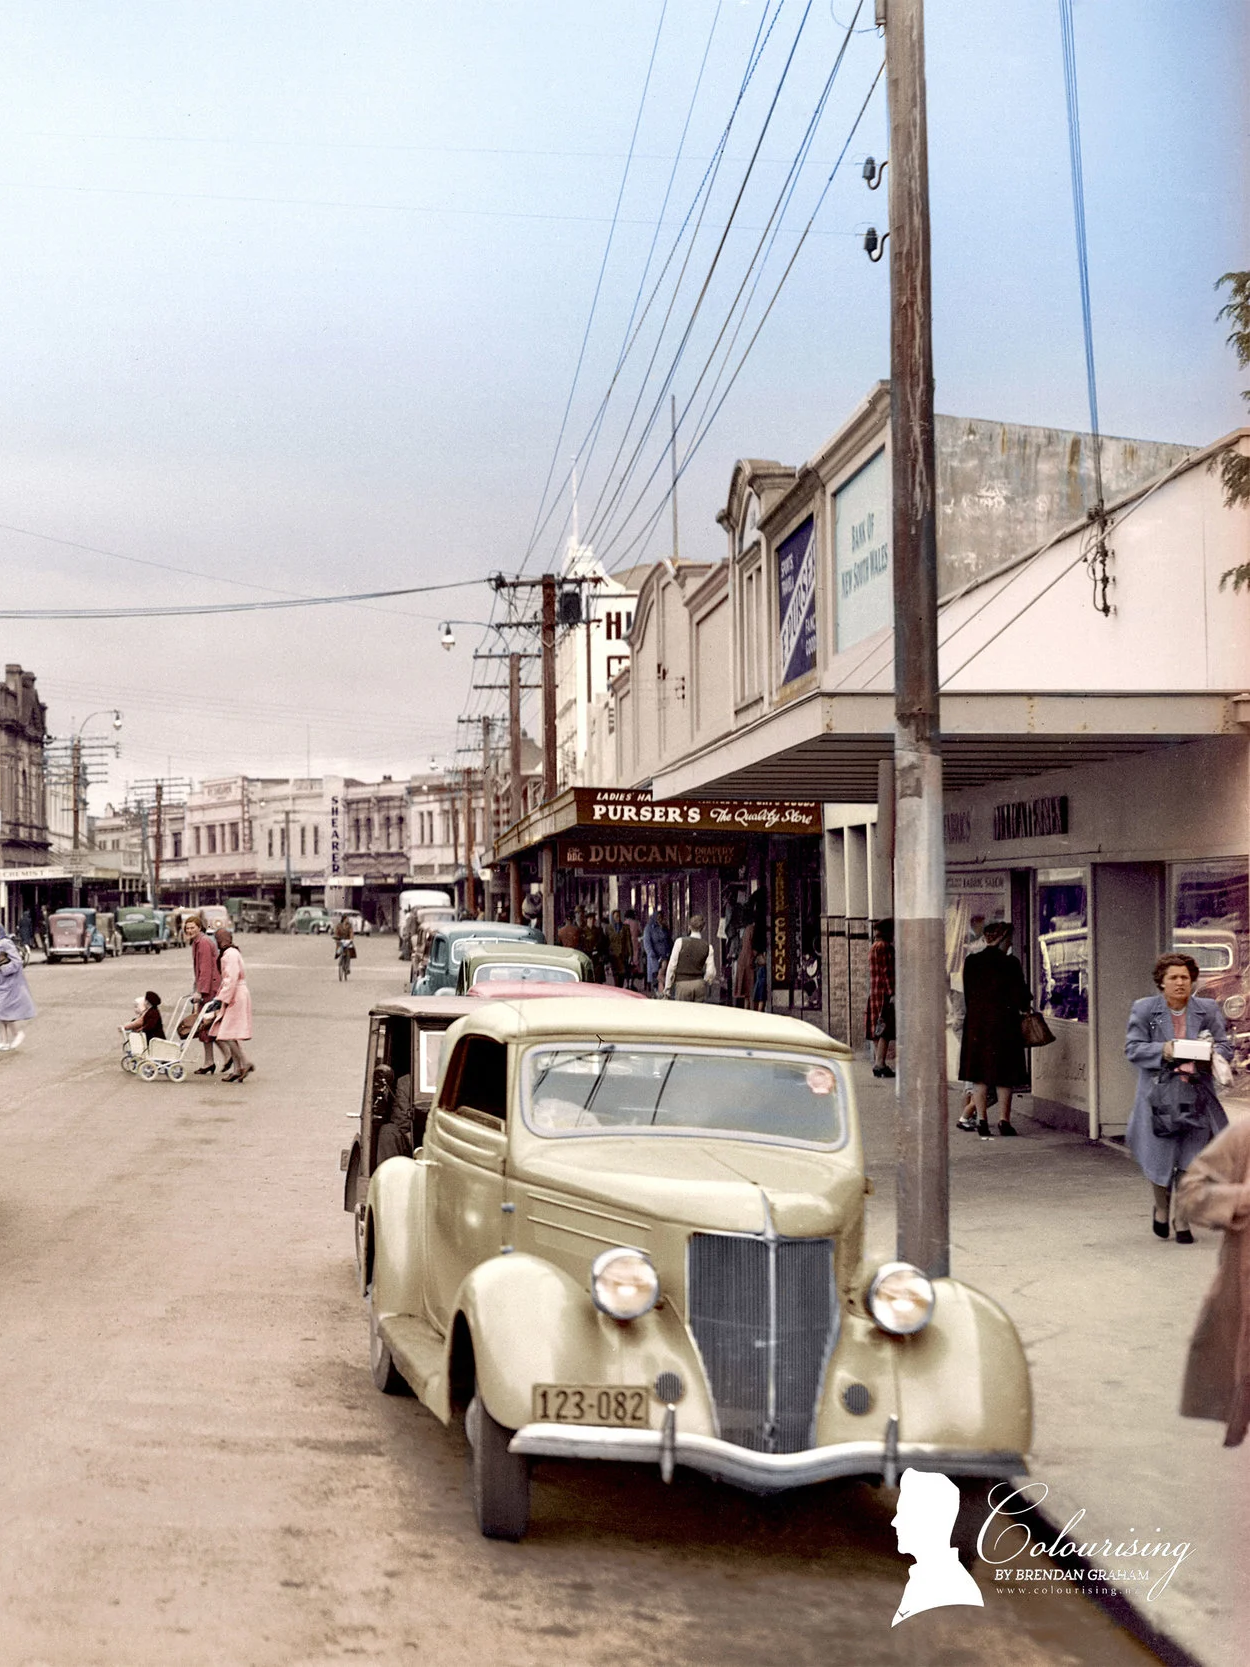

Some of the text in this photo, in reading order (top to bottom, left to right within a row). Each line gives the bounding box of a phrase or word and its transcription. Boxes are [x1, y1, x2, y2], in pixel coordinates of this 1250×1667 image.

[597, 791, 635, 802] LADIES'
[592, 804, 813, 828] PURSER'S The Quality Store
[775, 917, 786, 981] CLOTHING
[539, 1389, 644, 1421] 123-082
